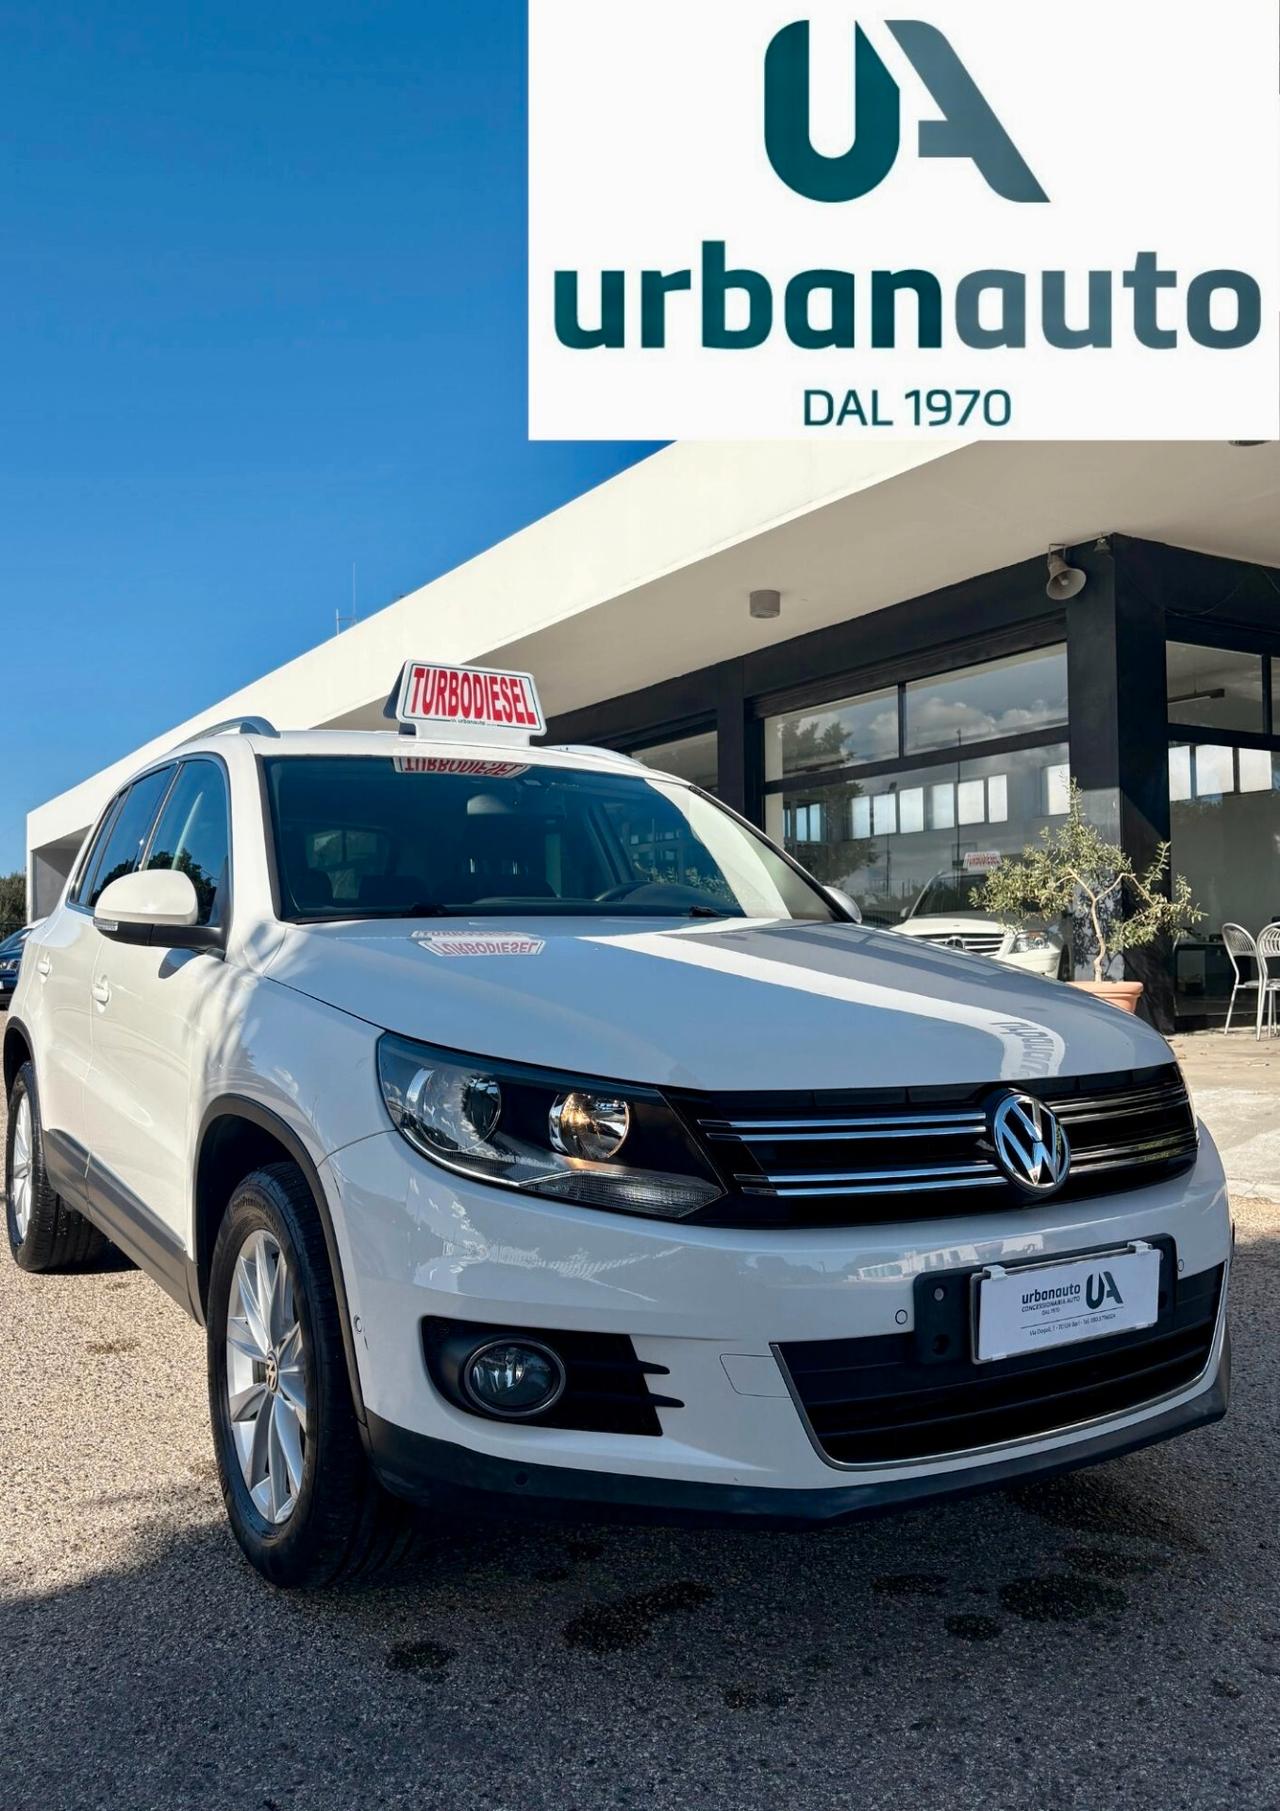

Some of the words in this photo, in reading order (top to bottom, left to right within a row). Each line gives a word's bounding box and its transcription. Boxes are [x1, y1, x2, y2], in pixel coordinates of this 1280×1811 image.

[411, 668, 537, 725] TURBODIESEL
[1021, 1283, 1081, 1305] urbanauto
[1021, 1299, 1066, 1313] CONCESSIONARIA
[1066, 1295, 1081, 1305] AUTO
[1086, 1271, 1124, 1309] UA
